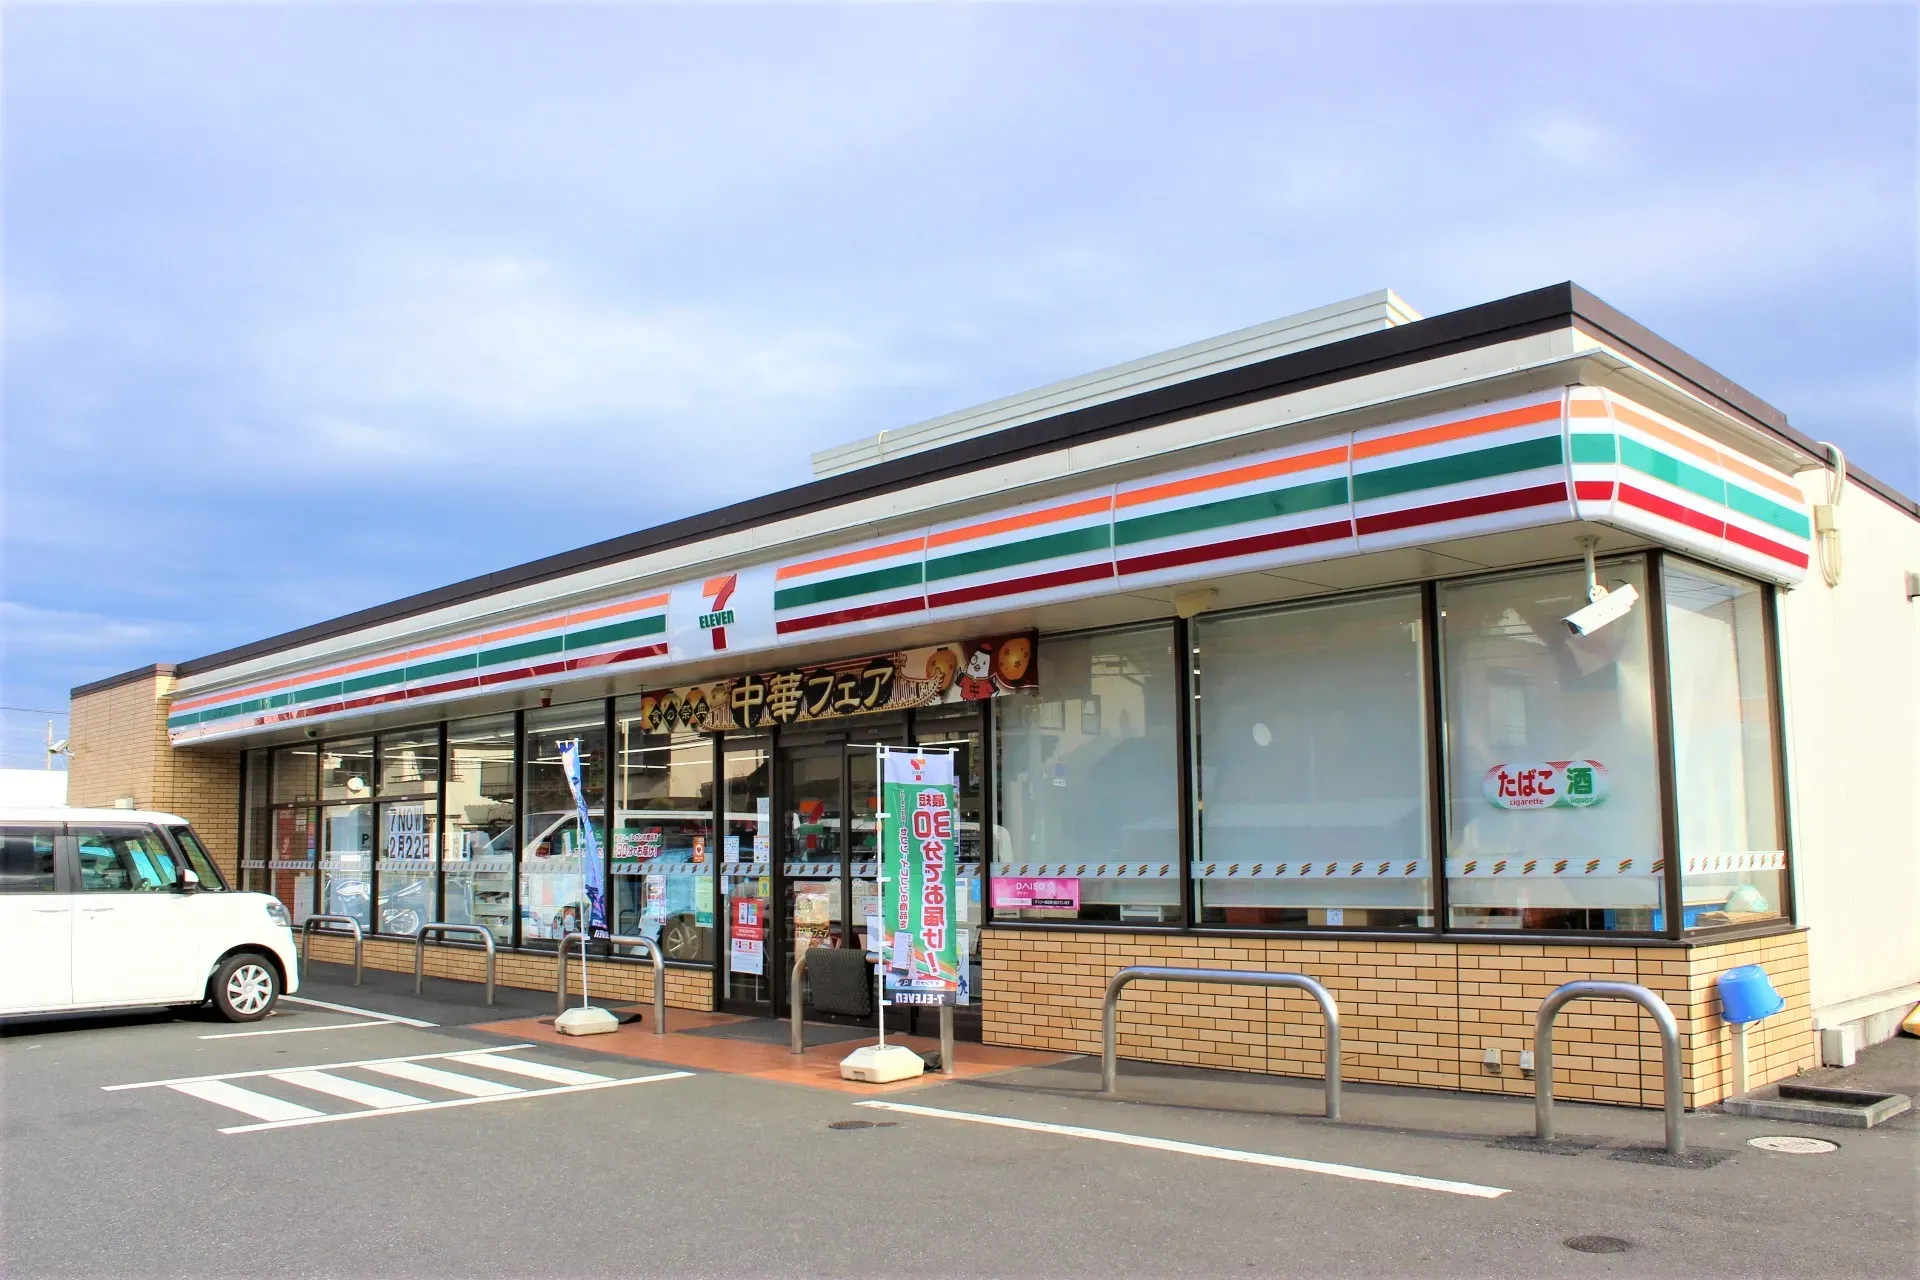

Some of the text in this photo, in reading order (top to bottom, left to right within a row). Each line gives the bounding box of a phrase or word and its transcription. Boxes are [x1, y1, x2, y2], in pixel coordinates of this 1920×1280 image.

[731, 666, 894, 728] 中華フェア
[651, 702, 708, 725] 食の祭典
[1498, 767, 1593, 797] たばこ 酒
[1509, 796, 1594, 807] cigarette liquor
[1016, 882, 1045, 891] DAISO
